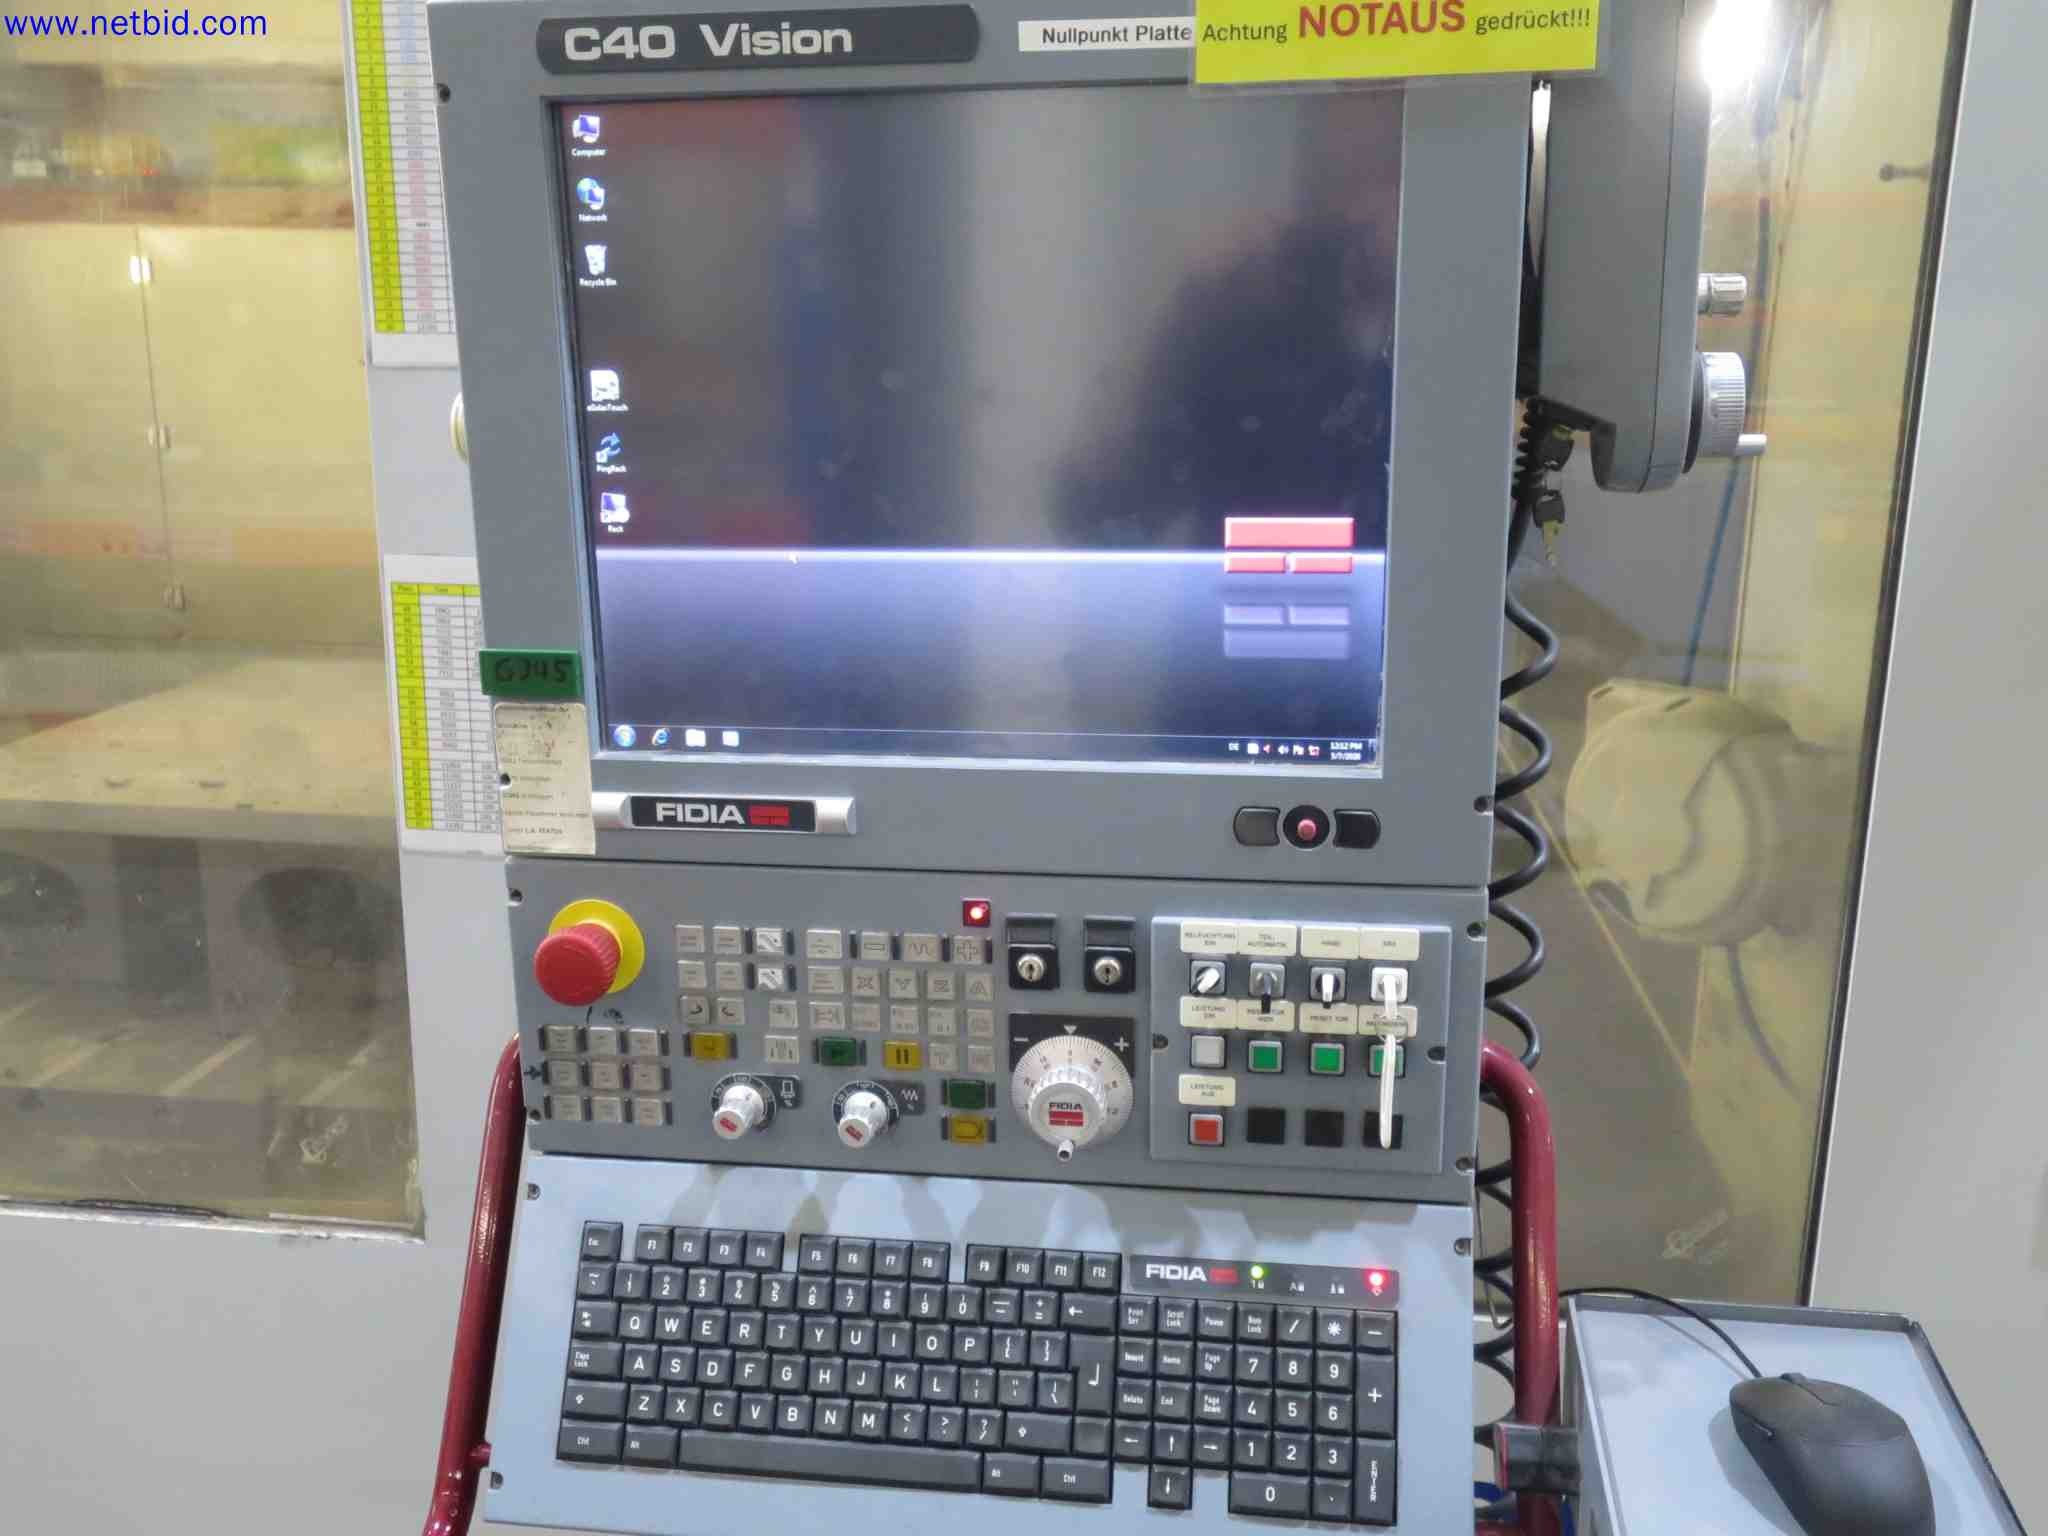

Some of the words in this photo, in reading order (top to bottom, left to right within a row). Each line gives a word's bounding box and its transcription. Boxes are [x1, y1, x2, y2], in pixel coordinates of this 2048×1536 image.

[1202, 22, 1289, 44] Achtung
[1298, 0, 1467, 39] NOTAUS
[1474, 8, 1591, 36] gedrückt!!!
[563, 26, 676, 61] C40
[699, 21, 854, 57] Vision
[1041, 26, 1130, 45] Nullpunkt
[1135, 25, 1193, 43] Platte
[571, 148, 607, 158] Computer
[655, 802, 745, 825] FIDIA
[1048, 1102, 1083, 1111] FIDIA
[648, 1240, 657, 1249] F1
[683, 1242, 693, 1252] F2
[720, 1245, 729, 1255] F3
[756, 1247, 766, 1257] F4
[811, 1250, 821, 1261] F5
[848, 1254, 858, 1264] F6
[886, 1256, 895, 1266] F7
[923, 1257, 933, 1268] F8
[980, 1261, 990, 1272] F9
[1016, 1263, 1029, 1274] F10
[1055, 1265, 1067, 1276] F11
[1093, 1266, 1106, 1278] F12
[1145, 1263, 1207, 1282] FIDIA
[662, 1284, 670, 1295] 2
[699, 1286, 705, 1297] 3
[771, 1291, 778, 1302] 5
[808, 1294, 816, 1305] 6
[846, 1295, 854, 1307] 7
[883, 1298, 891, 1310] 8
[921, 1303, 928, 1314] 9
[959, 1303, 966, 1314] 0
[630, 1317, 640, 1330] Q
[664, 1318, 680, 1333] W
[702, 1320, 712, 1334] E
[740, 1323, 750, 1337] R
[1248, 1324, 1262, 1333] Lock
[777, 1326, 786, 1339] T
[815, 1328, 824, 1342] Y
[851, 1330, 861, 1344] U
[891, 1334, 896, 1347] I
[927, 1336, 937, 1350] O
[965, 1338, 975, 1351] P
[634, 1357, 644, 1369] A
[670, 1359, 681, 1373] S
[707, 1362, 717, 1376] D
[1249, 1359, 1258, 1373] 7
[1288, 1361, 1297, 1375] 8
[744, 1364, 754, 1378] F
[782, 1367, 792, 1381] G
[819, 1370, 830, 1384] H
[1330, 1364, 1338, 1378] 9
[857, 1372, 865, 1386] J
[895, 1375, 905, 1389] K
[933, 1378, 941, 1392] L
[639, 1396, 650, 1411] Z
[675, 1399, 686, 1413] X
[1161, 1396, 1174, 1405] End
[713, 1403, 723, 1416] C
[752, 1404, 761, 1419] V
[787, 1407, 797, 1422] B
[1248, 1401, 1256, 1415] 4
[1288, 1403, 1297, 1417] 5
[1328, 1406, 1338, 1420] 6
[825, 1411, 836, 1425] N
[862, 1414, 874, 1429] M
[1249, 1443, 1254, 1456] 1
[1287, 1446, 1297, 1460] 2
[1328, 1450, 1337, 1464] 3
[1265, 1487, 1275, 1501] 0
